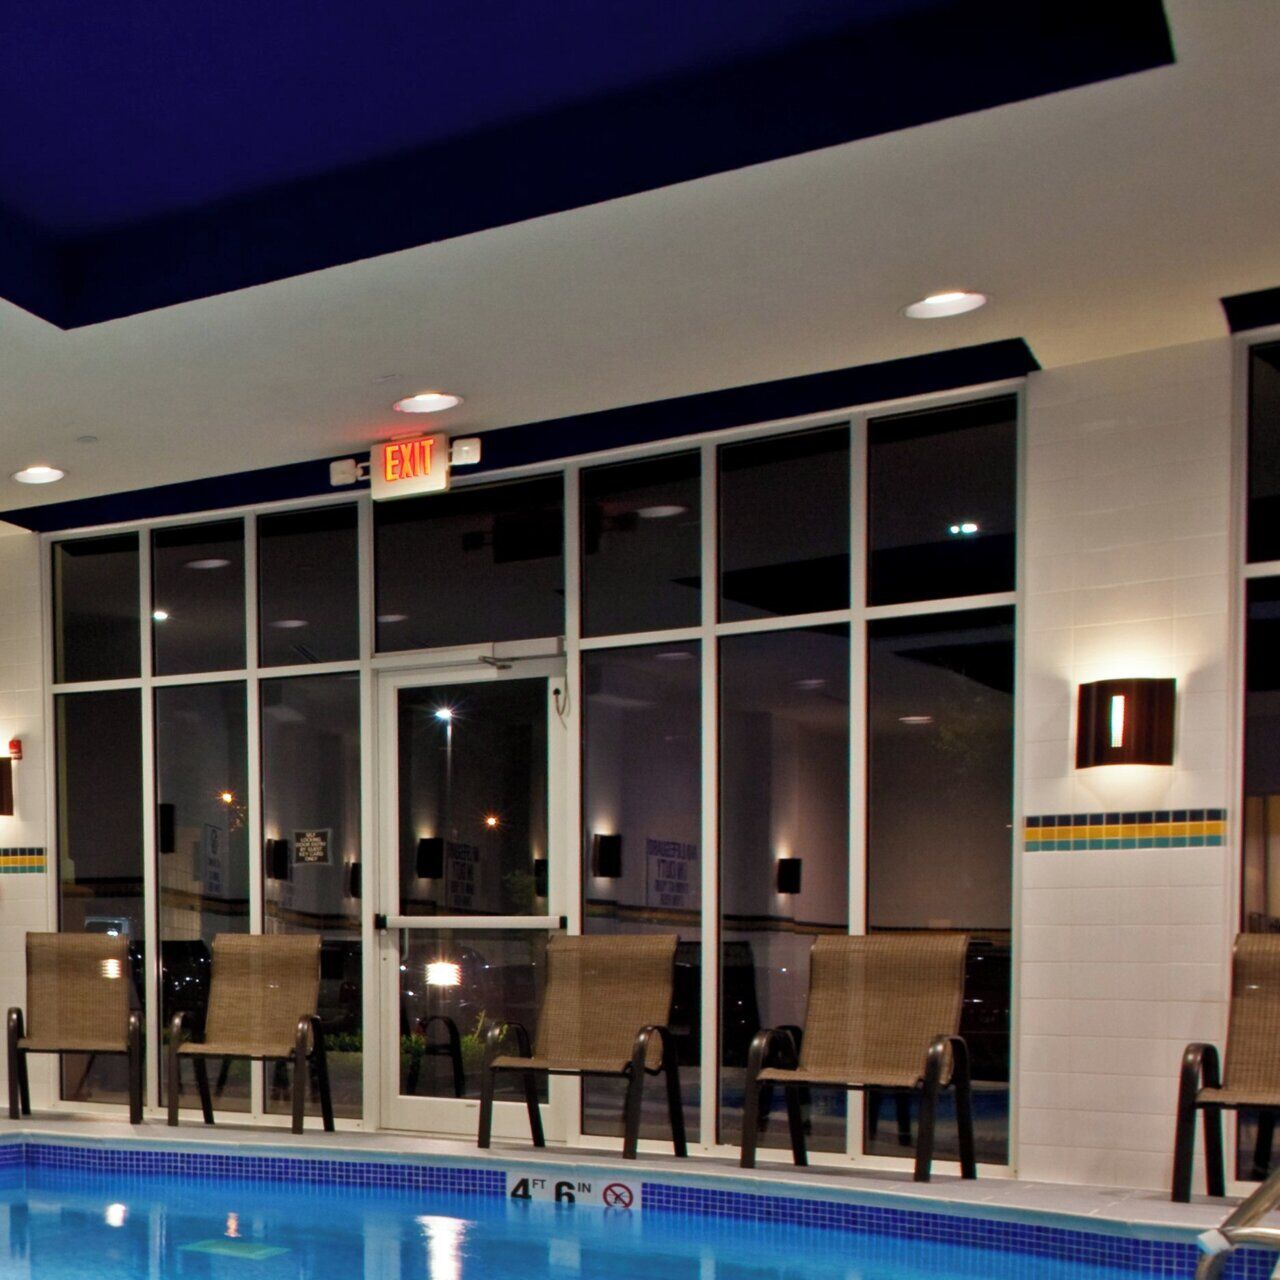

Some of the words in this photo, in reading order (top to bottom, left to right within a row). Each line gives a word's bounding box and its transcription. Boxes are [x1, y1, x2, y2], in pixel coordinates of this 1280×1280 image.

[385, 439, 434, 482] EXIT
[510, 1178, 532, 1199] 4
[532, 1179, 546, 1189] FT
[554, 1181, 576, 1203] 6
[578, 1182, 591, 1193] IN
